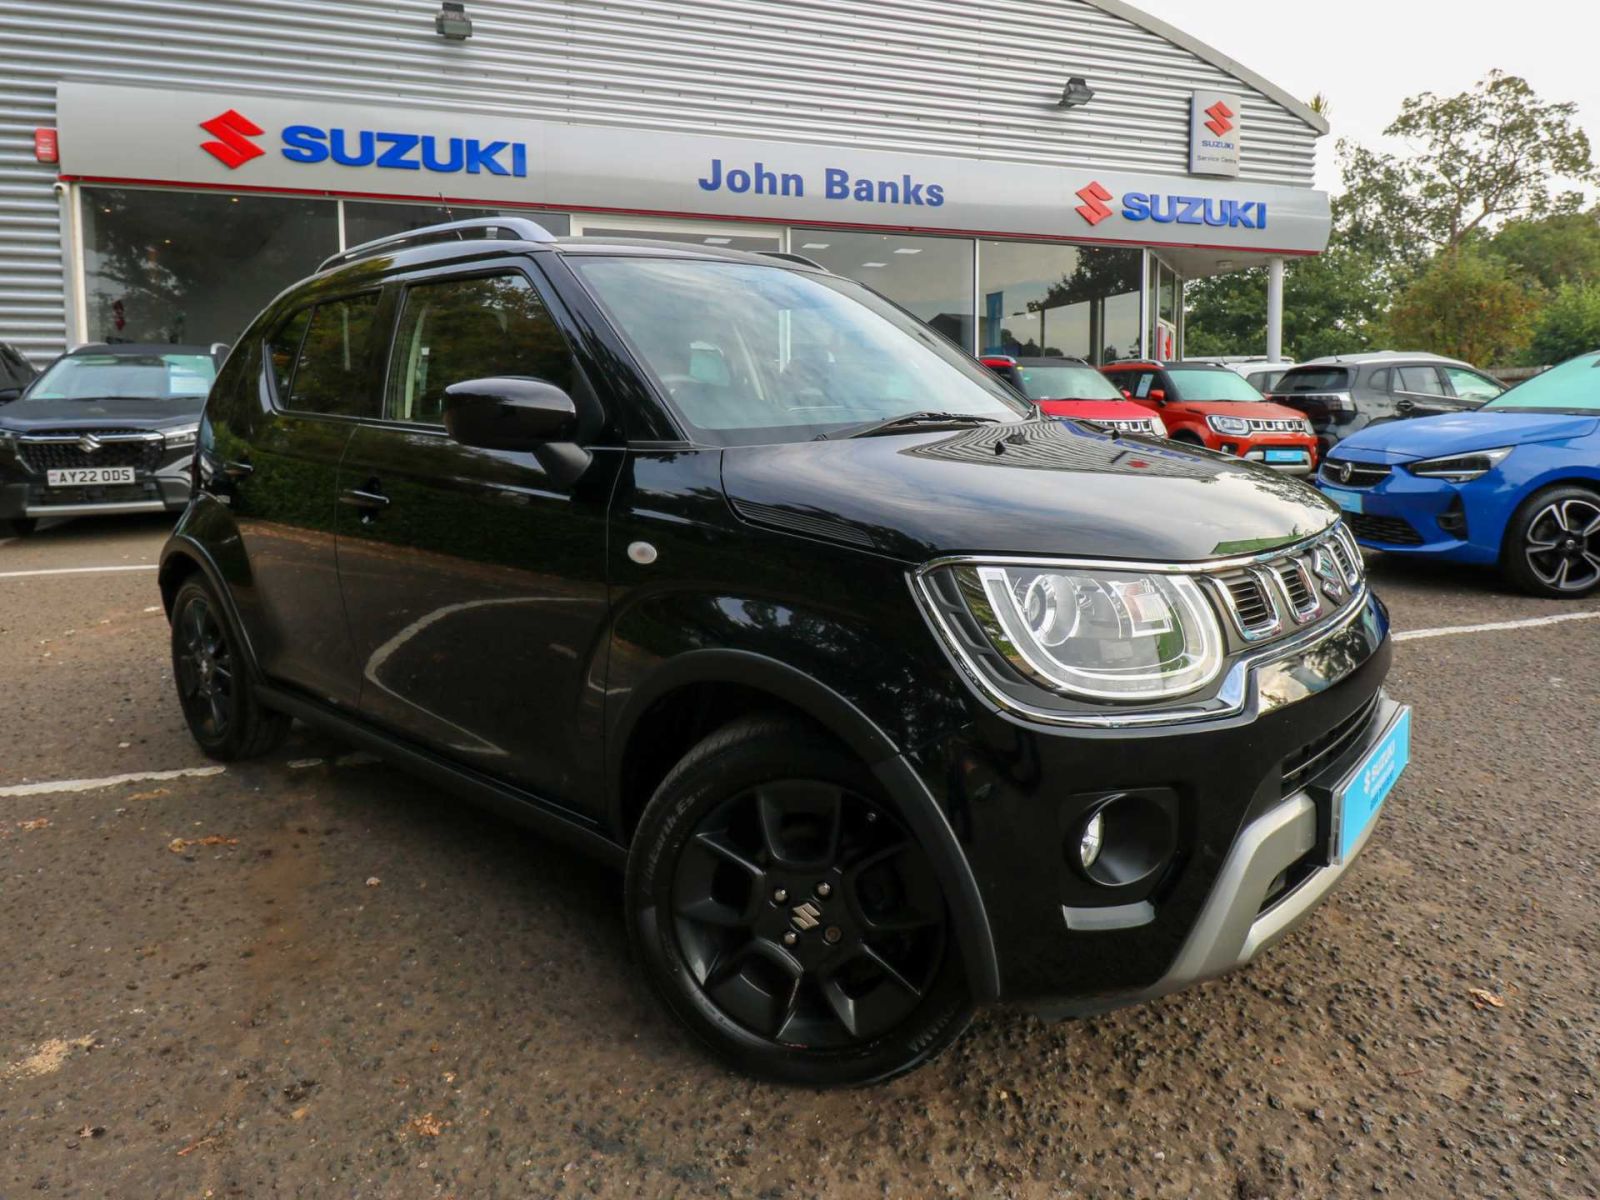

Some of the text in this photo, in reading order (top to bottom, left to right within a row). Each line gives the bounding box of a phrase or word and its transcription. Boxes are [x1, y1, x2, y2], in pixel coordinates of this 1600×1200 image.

[281, 124, 528, 178] SUZUKI
[699, 159, 945, 209] John Banks
[1122, 191, 1267, 230] SUZUKI
[60, 470, 98, 482] AY22
